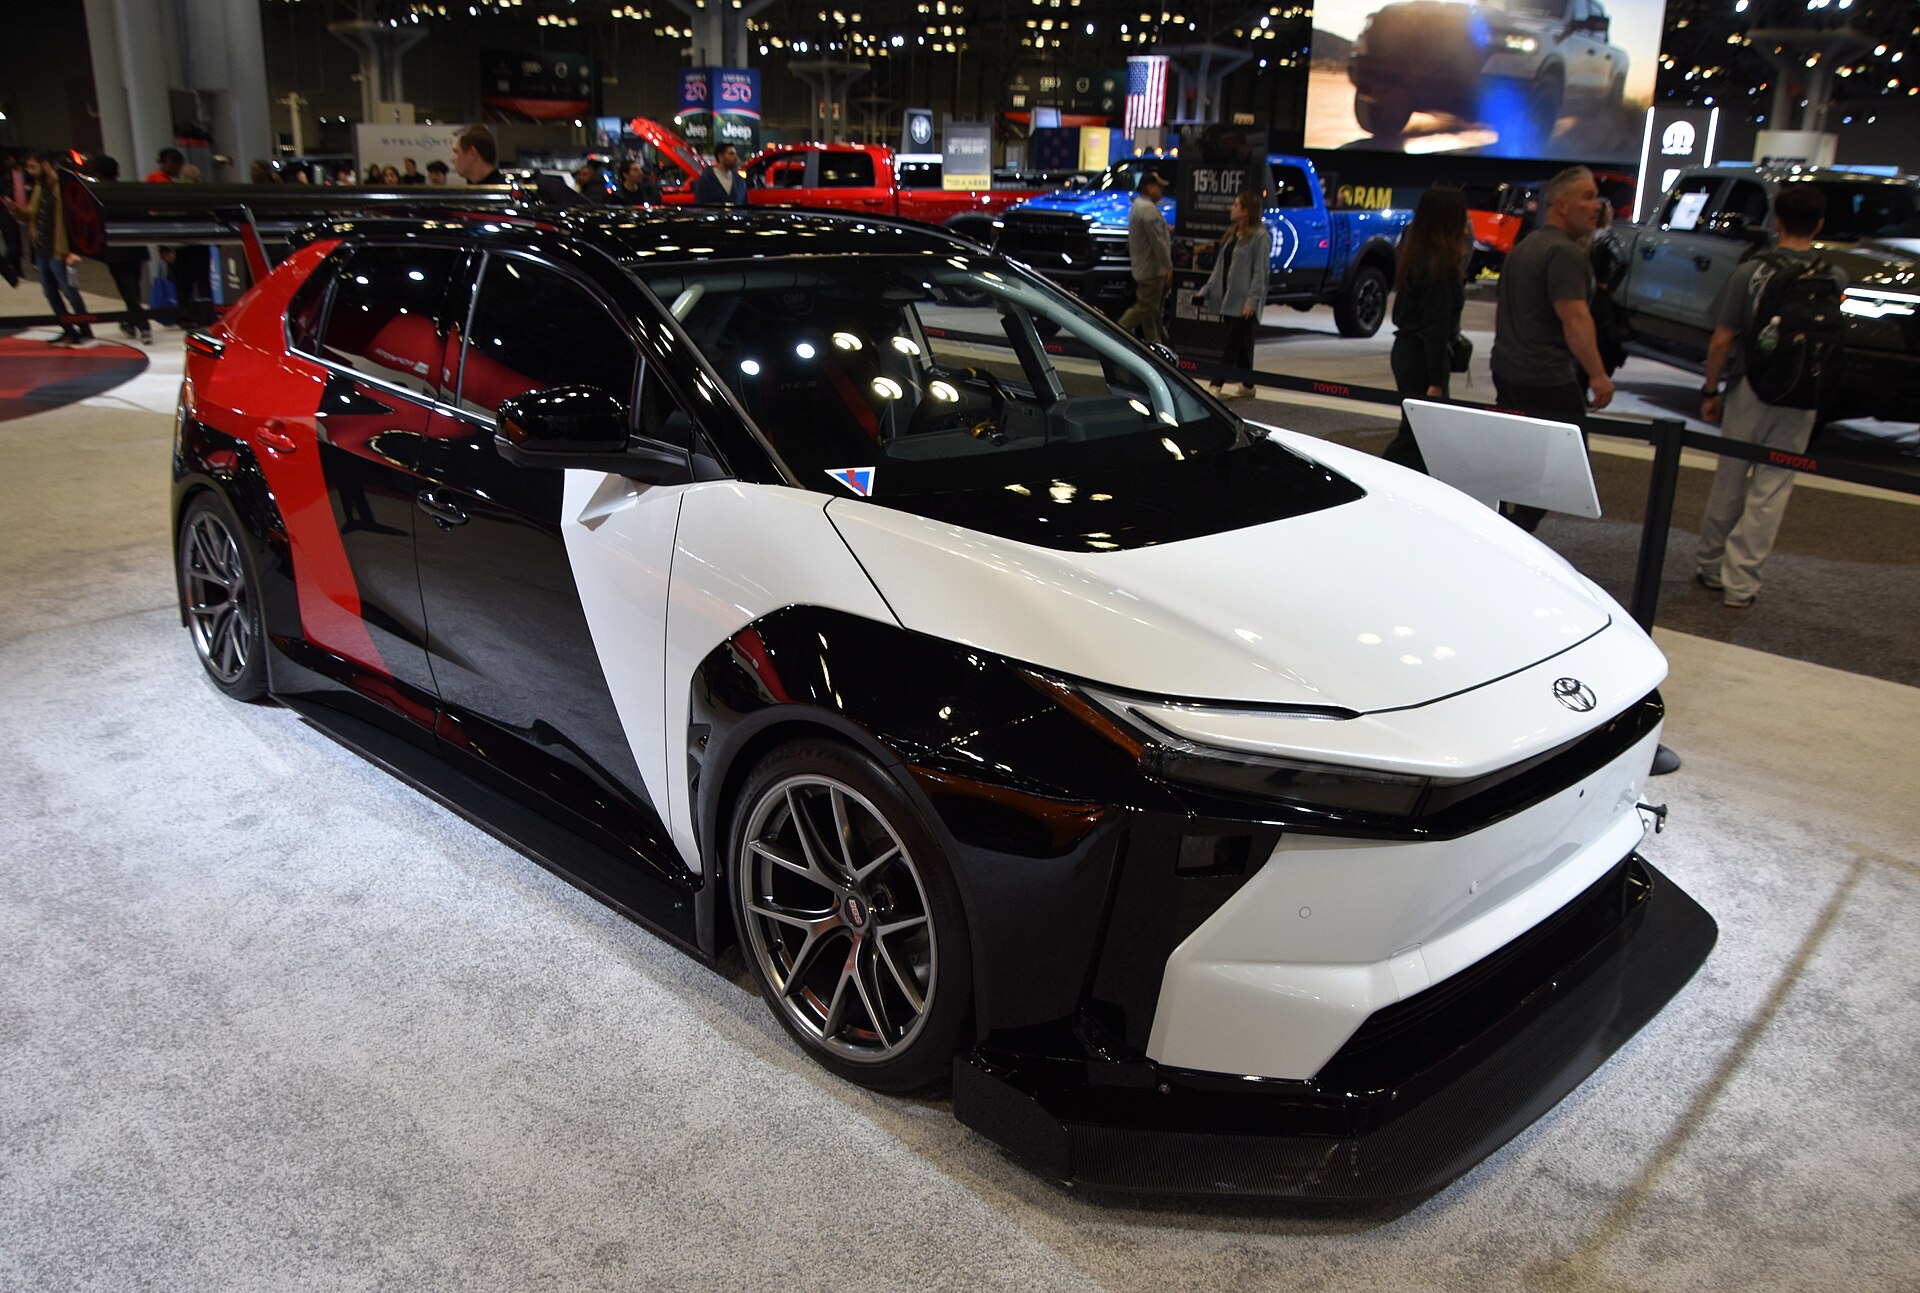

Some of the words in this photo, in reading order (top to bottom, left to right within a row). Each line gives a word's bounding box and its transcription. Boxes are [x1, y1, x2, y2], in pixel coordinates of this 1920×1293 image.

[684, 81, 708, 101] 250
[721, 82, 752, 103] 250
[685, 121, 708, 138] Jeep
[722, 121, 752, 140] Jeep
[1193, 169, 1219, 193] 15%
[1353, 185, 1393, 209] RAM
[1312, 382, 1350, 396] TOYOTA
[1769, 450, 1818, 471] TOYOTA
